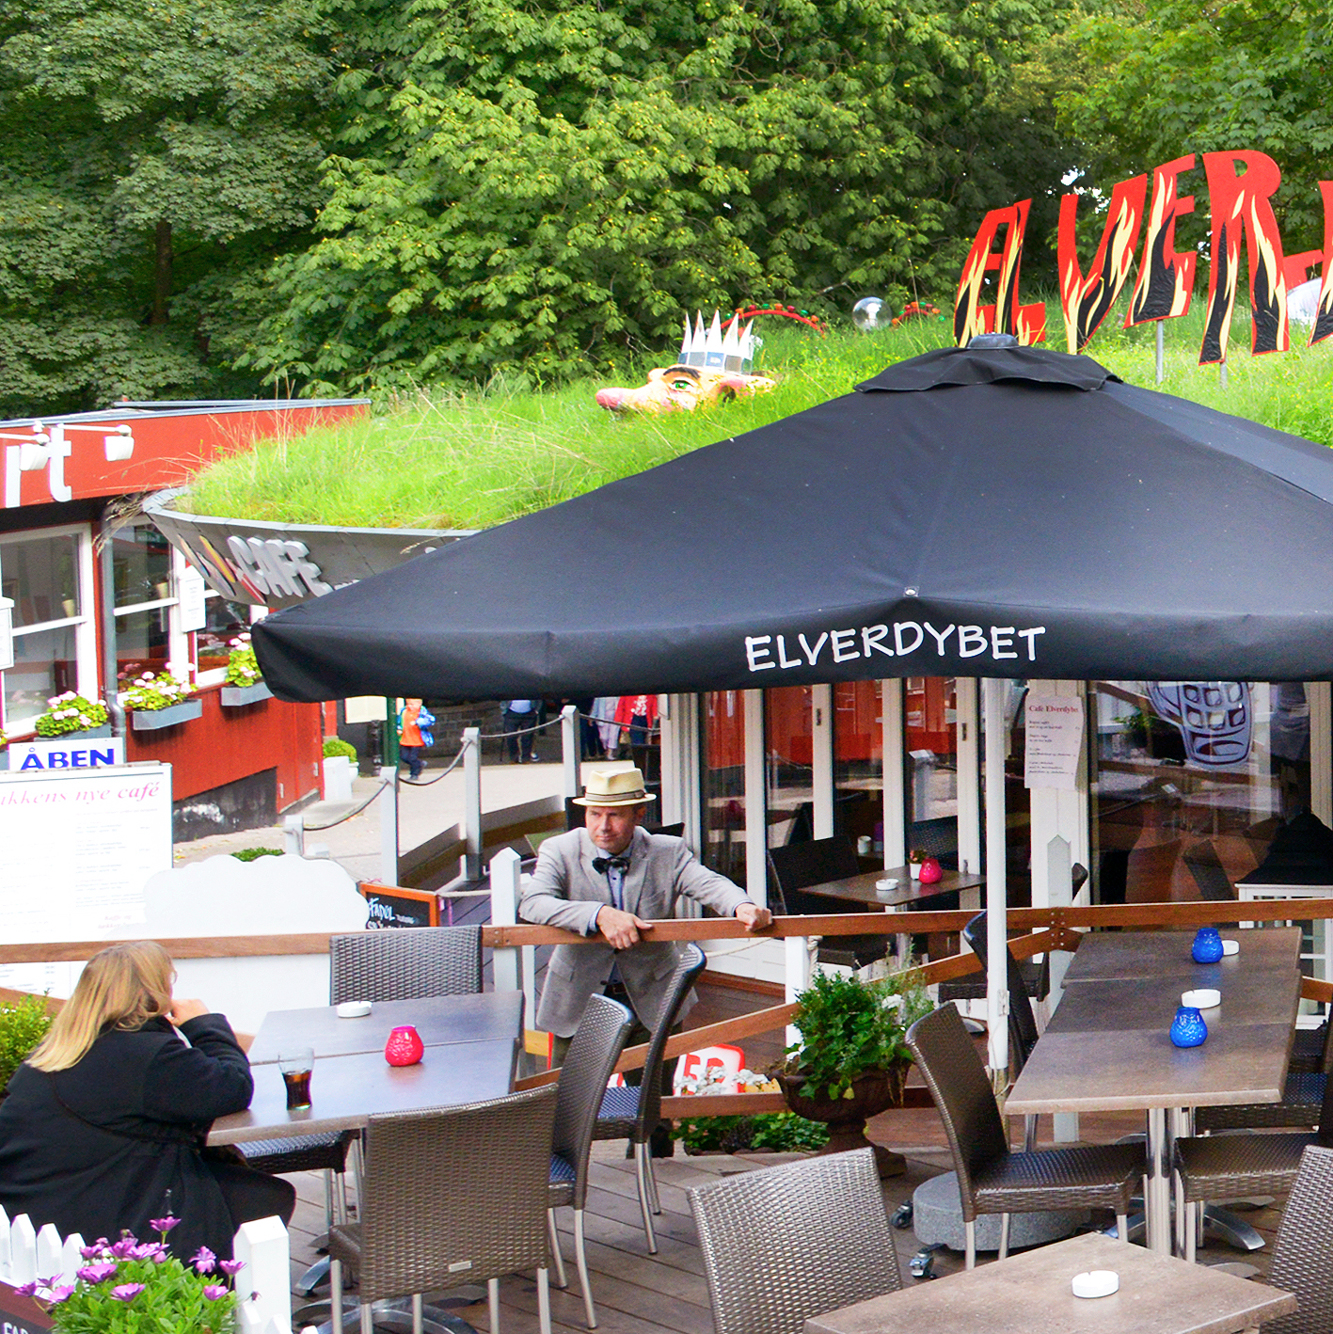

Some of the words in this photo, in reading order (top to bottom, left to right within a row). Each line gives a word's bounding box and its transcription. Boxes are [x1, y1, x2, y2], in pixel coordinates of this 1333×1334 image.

[745, 621, 1046, 671] ELVERDYBET
[20, 747, 115, 771] ÅBEN
[117, 781, 161, 802] café
